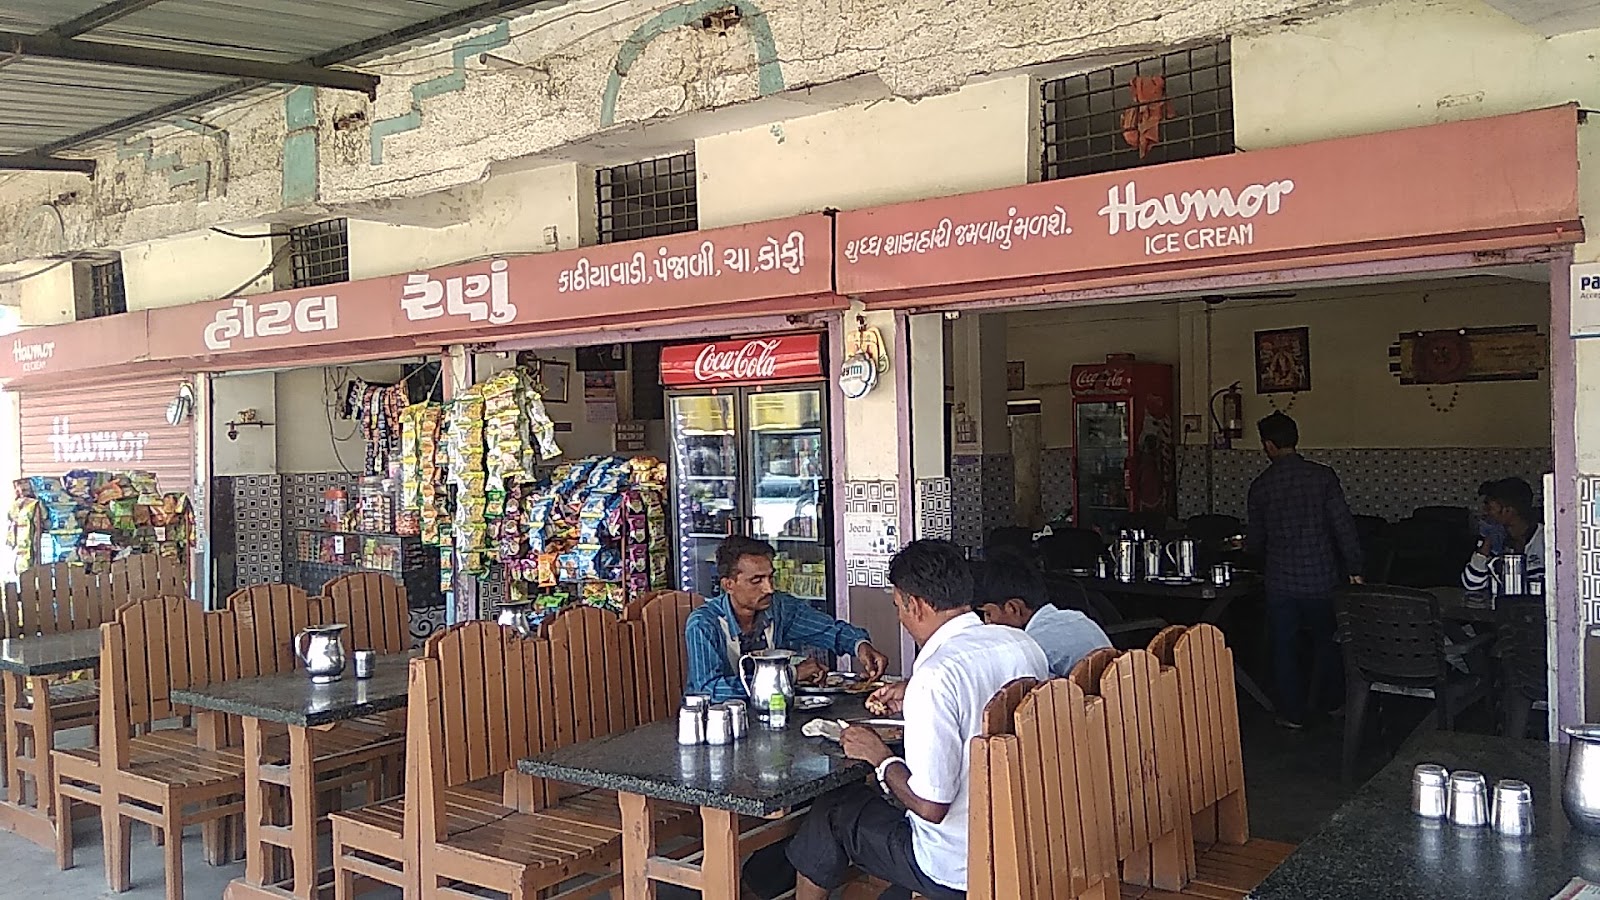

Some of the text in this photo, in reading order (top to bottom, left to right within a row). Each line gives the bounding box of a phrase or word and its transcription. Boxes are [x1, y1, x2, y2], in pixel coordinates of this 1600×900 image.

[1098, 180, 1294, 235] Havmor
[884, 217, 953, 256] શાકાહારી
[1145, 223, 1253, 255] ICE CREAM
[203, 295, 339, 350] હોટલ
